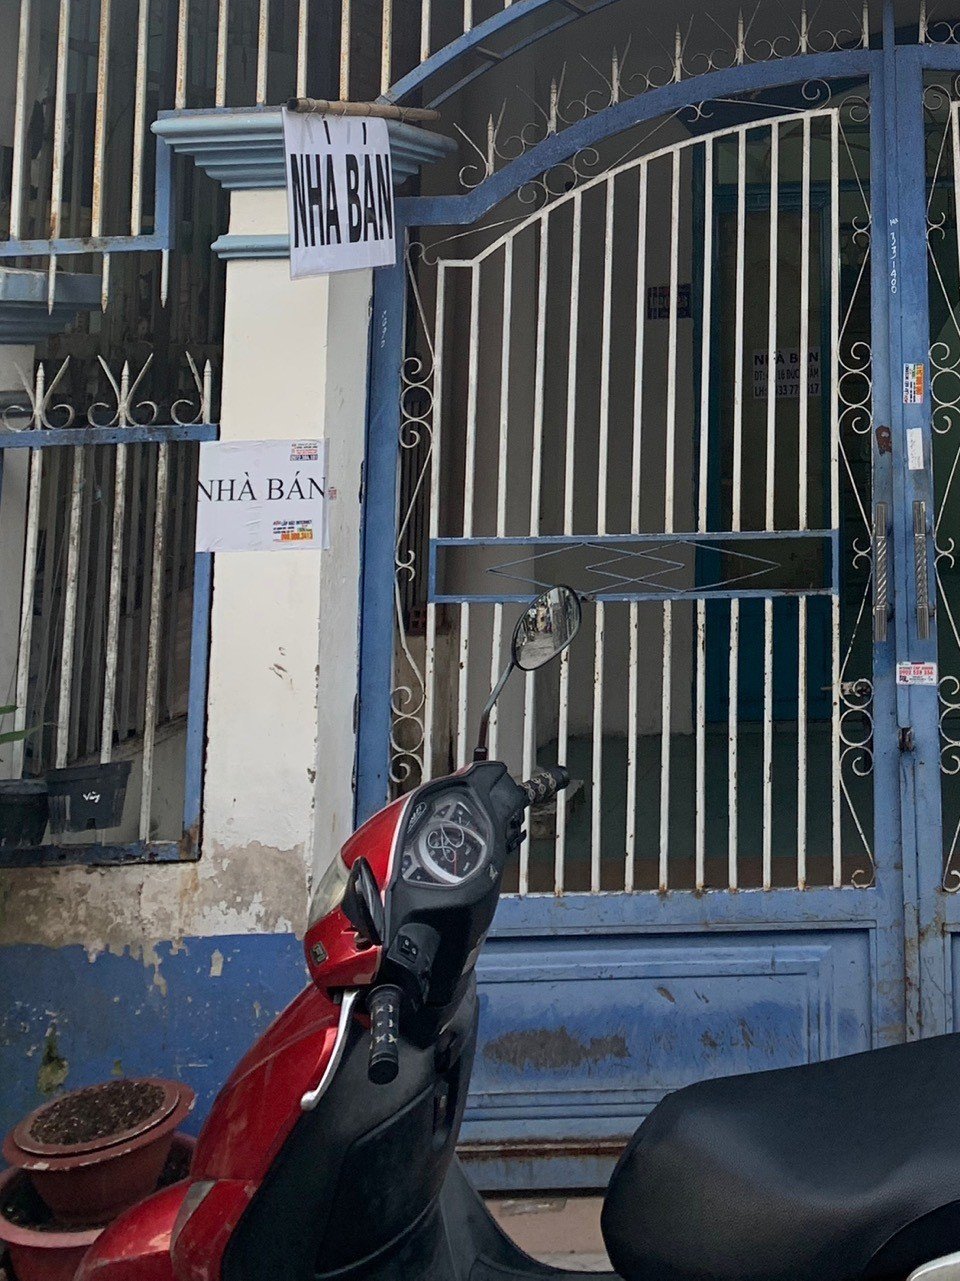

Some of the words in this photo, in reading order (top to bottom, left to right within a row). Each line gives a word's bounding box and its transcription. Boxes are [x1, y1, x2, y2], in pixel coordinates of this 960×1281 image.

[290, 120, 341, 248] NHÀ
[345, 122, 393, 244] BÁN
[790, 352, 819, 363] BN
[197, 471, 257, 503] NHÀ
[266, 470, 326, 501] BÁN
